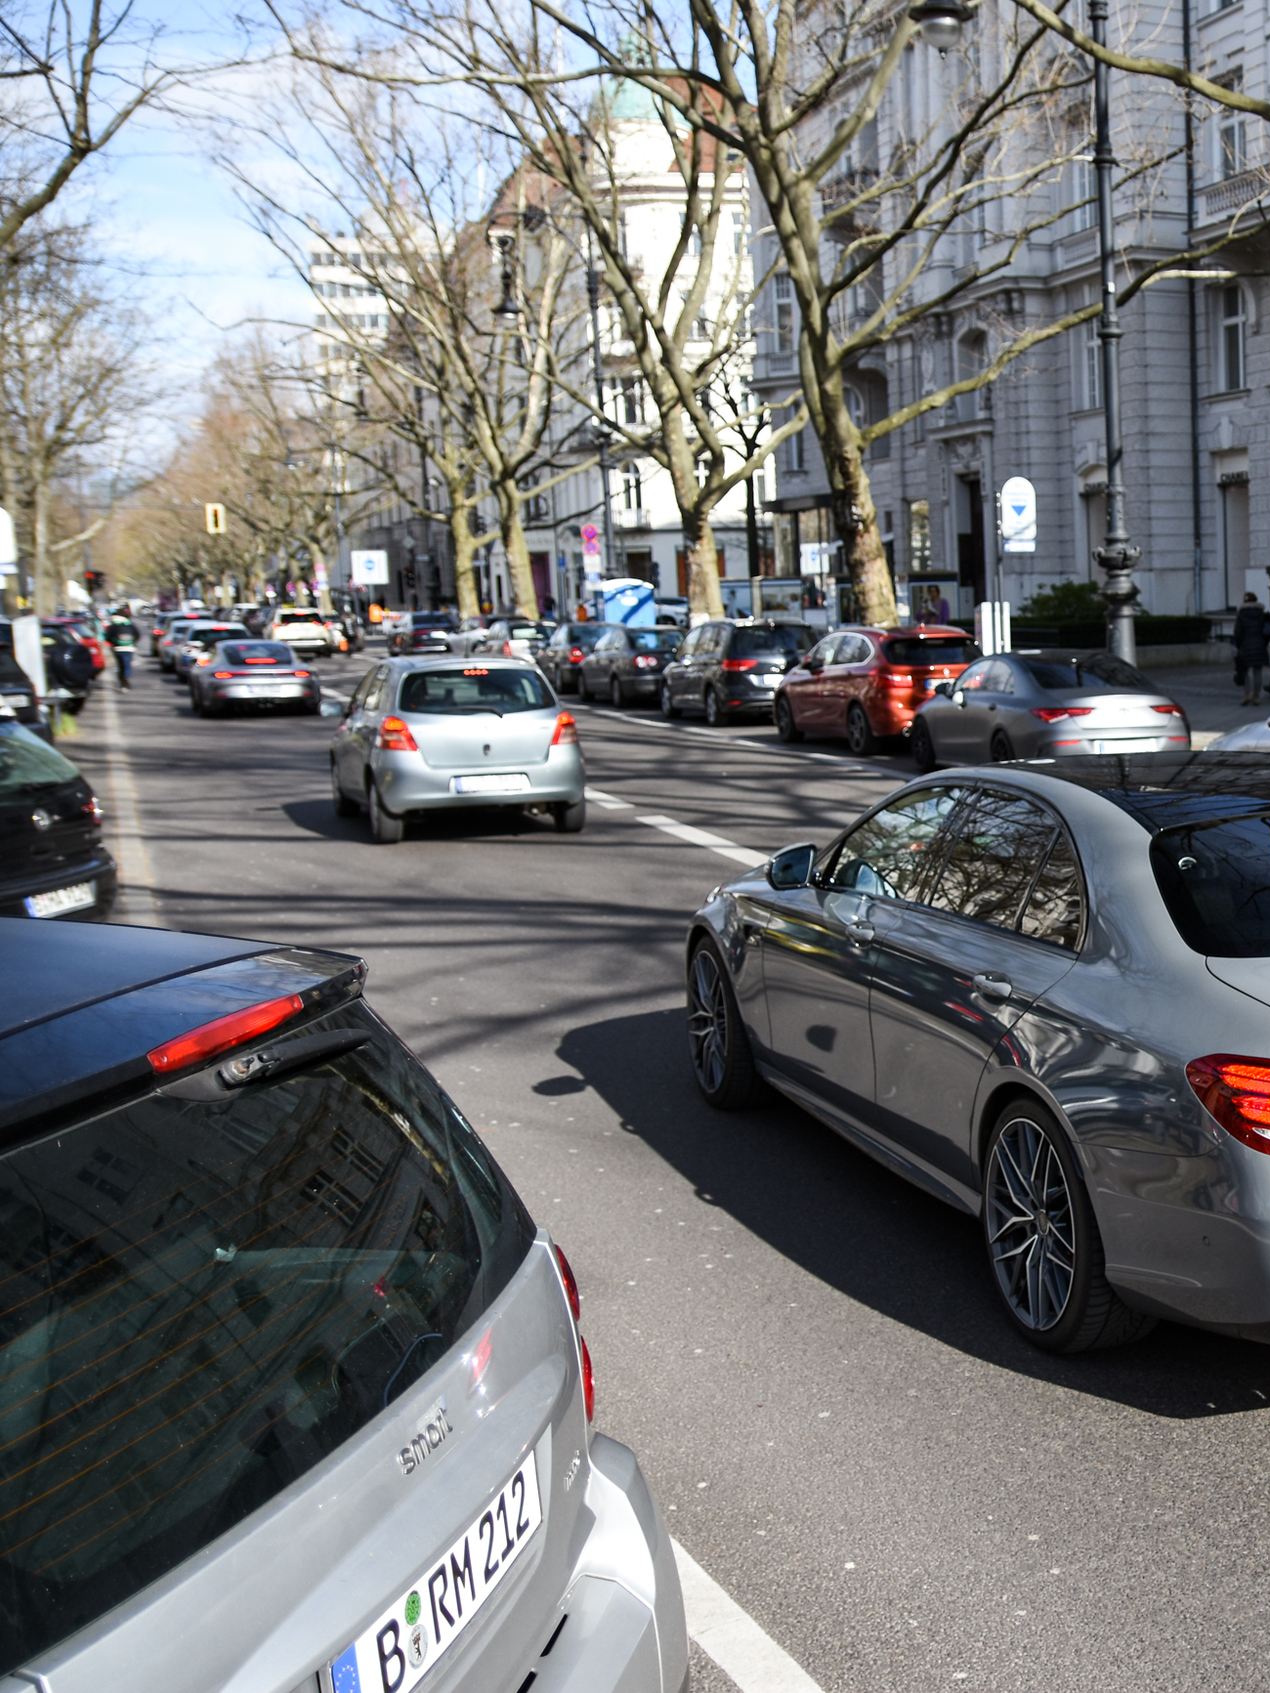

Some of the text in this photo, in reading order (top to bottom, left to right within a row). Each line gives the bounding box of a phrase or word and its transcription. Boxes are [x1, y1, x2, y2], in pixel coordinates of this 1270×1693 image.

[398, 1407, 453, 1475] smart
[376, 1470, 530, 1693] B RM 212
